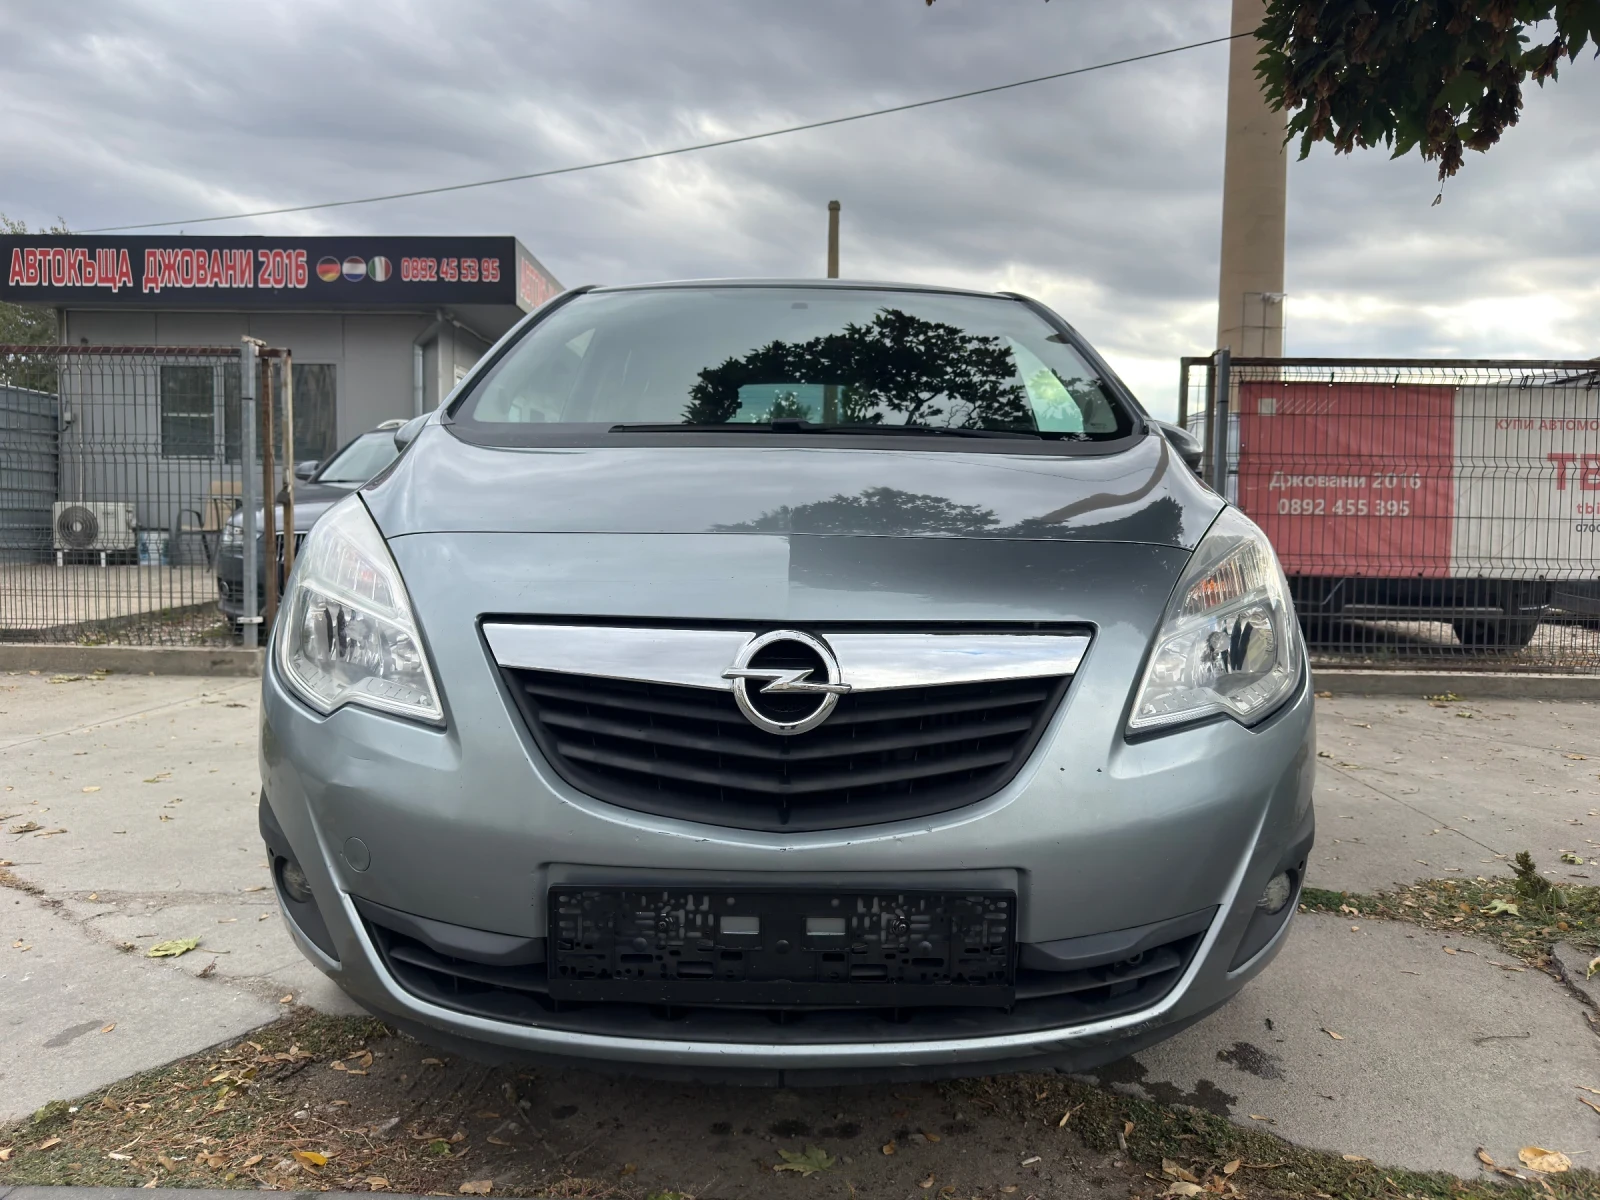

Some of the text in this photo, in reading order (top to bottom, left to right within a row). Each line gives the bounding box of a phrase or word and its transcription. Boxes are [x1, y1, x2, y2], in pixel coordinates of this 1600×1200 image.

[9, 248, 308, 293] АВТОКЪЩА ДЖОВАНИ 2016
[401, 257, 437, 281] 0892
[440, 258, 458, 281] 45
[460, 258, 479, 282] 53
[481, 258, 500, 282] 95
[1496, 419, 1534, 430] КУПИ
[1269, 472, 1421, 491] Джовани 2016
[1278, 499, 1410, 516] 0892 455 395
